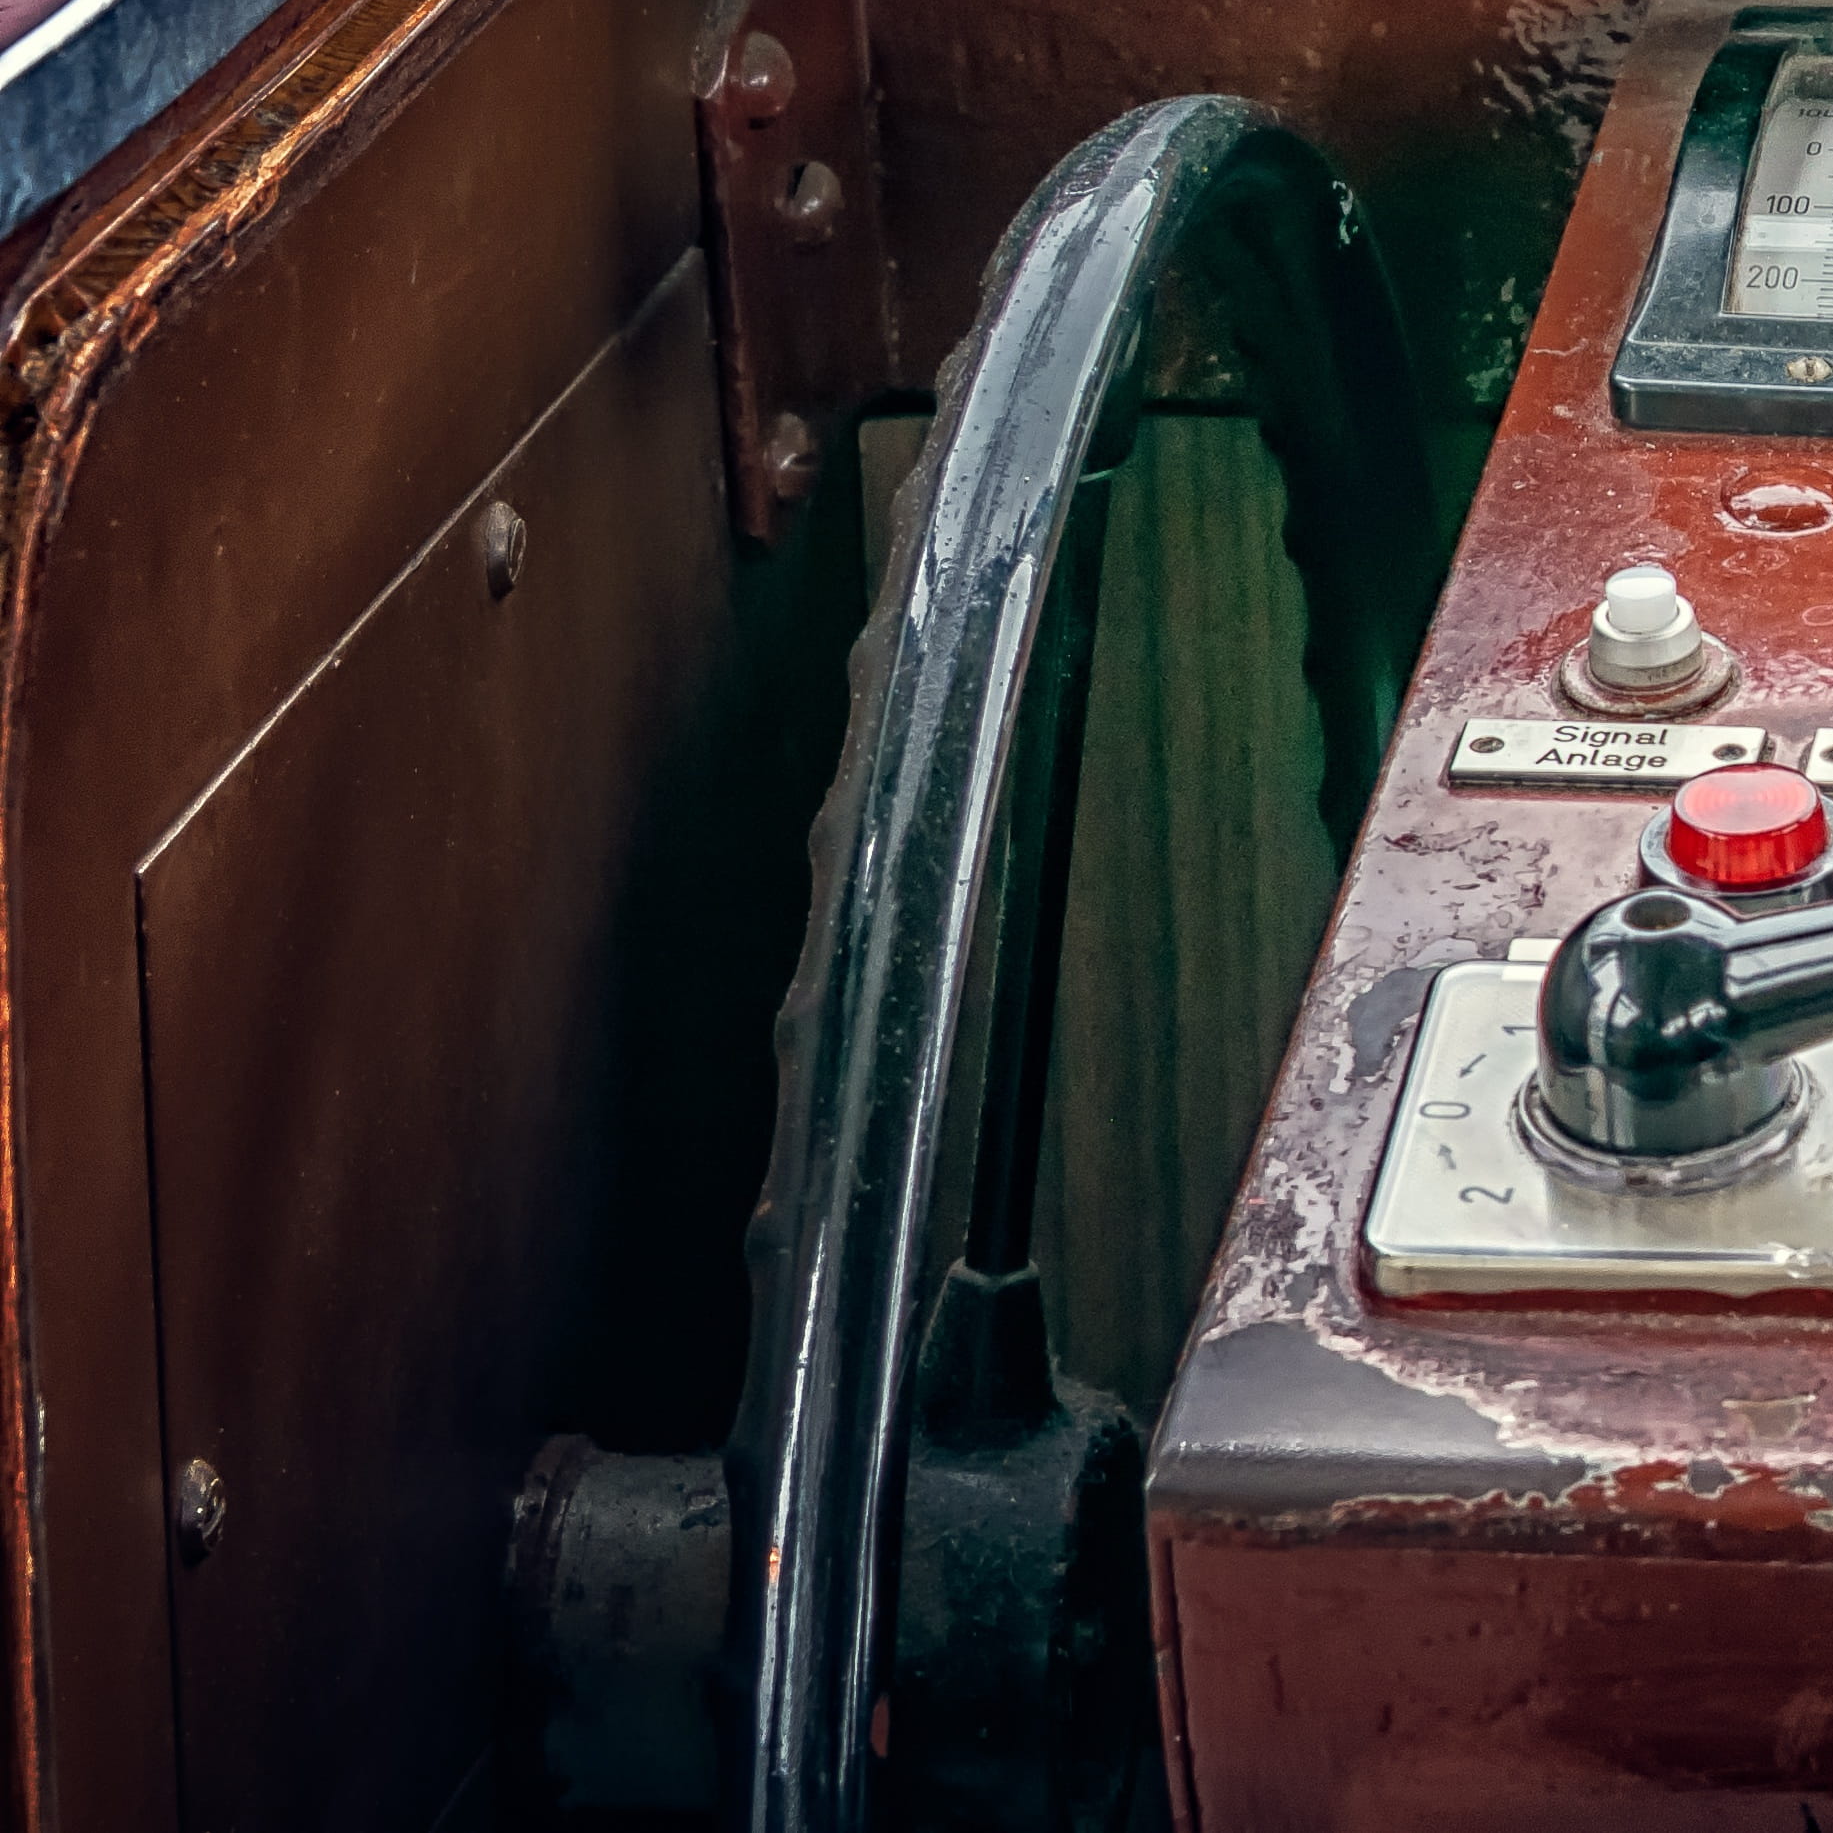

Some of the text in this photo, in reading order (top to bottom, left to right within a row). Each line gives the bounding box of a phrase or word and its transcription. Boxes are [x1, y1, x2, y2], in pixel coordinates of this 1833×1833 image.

[1805, 140, 1822, 156] 0
[1765, 193, 1811, 215] 100
[1744, 264, 1800, 290] 200
[1552, 725, 1669, 748] Signal
[1535, 748, 1669, 771] Anlage
[1419, 1100, 1472, 1120] 0
[1458, 1186, 1515, 1205] 2
